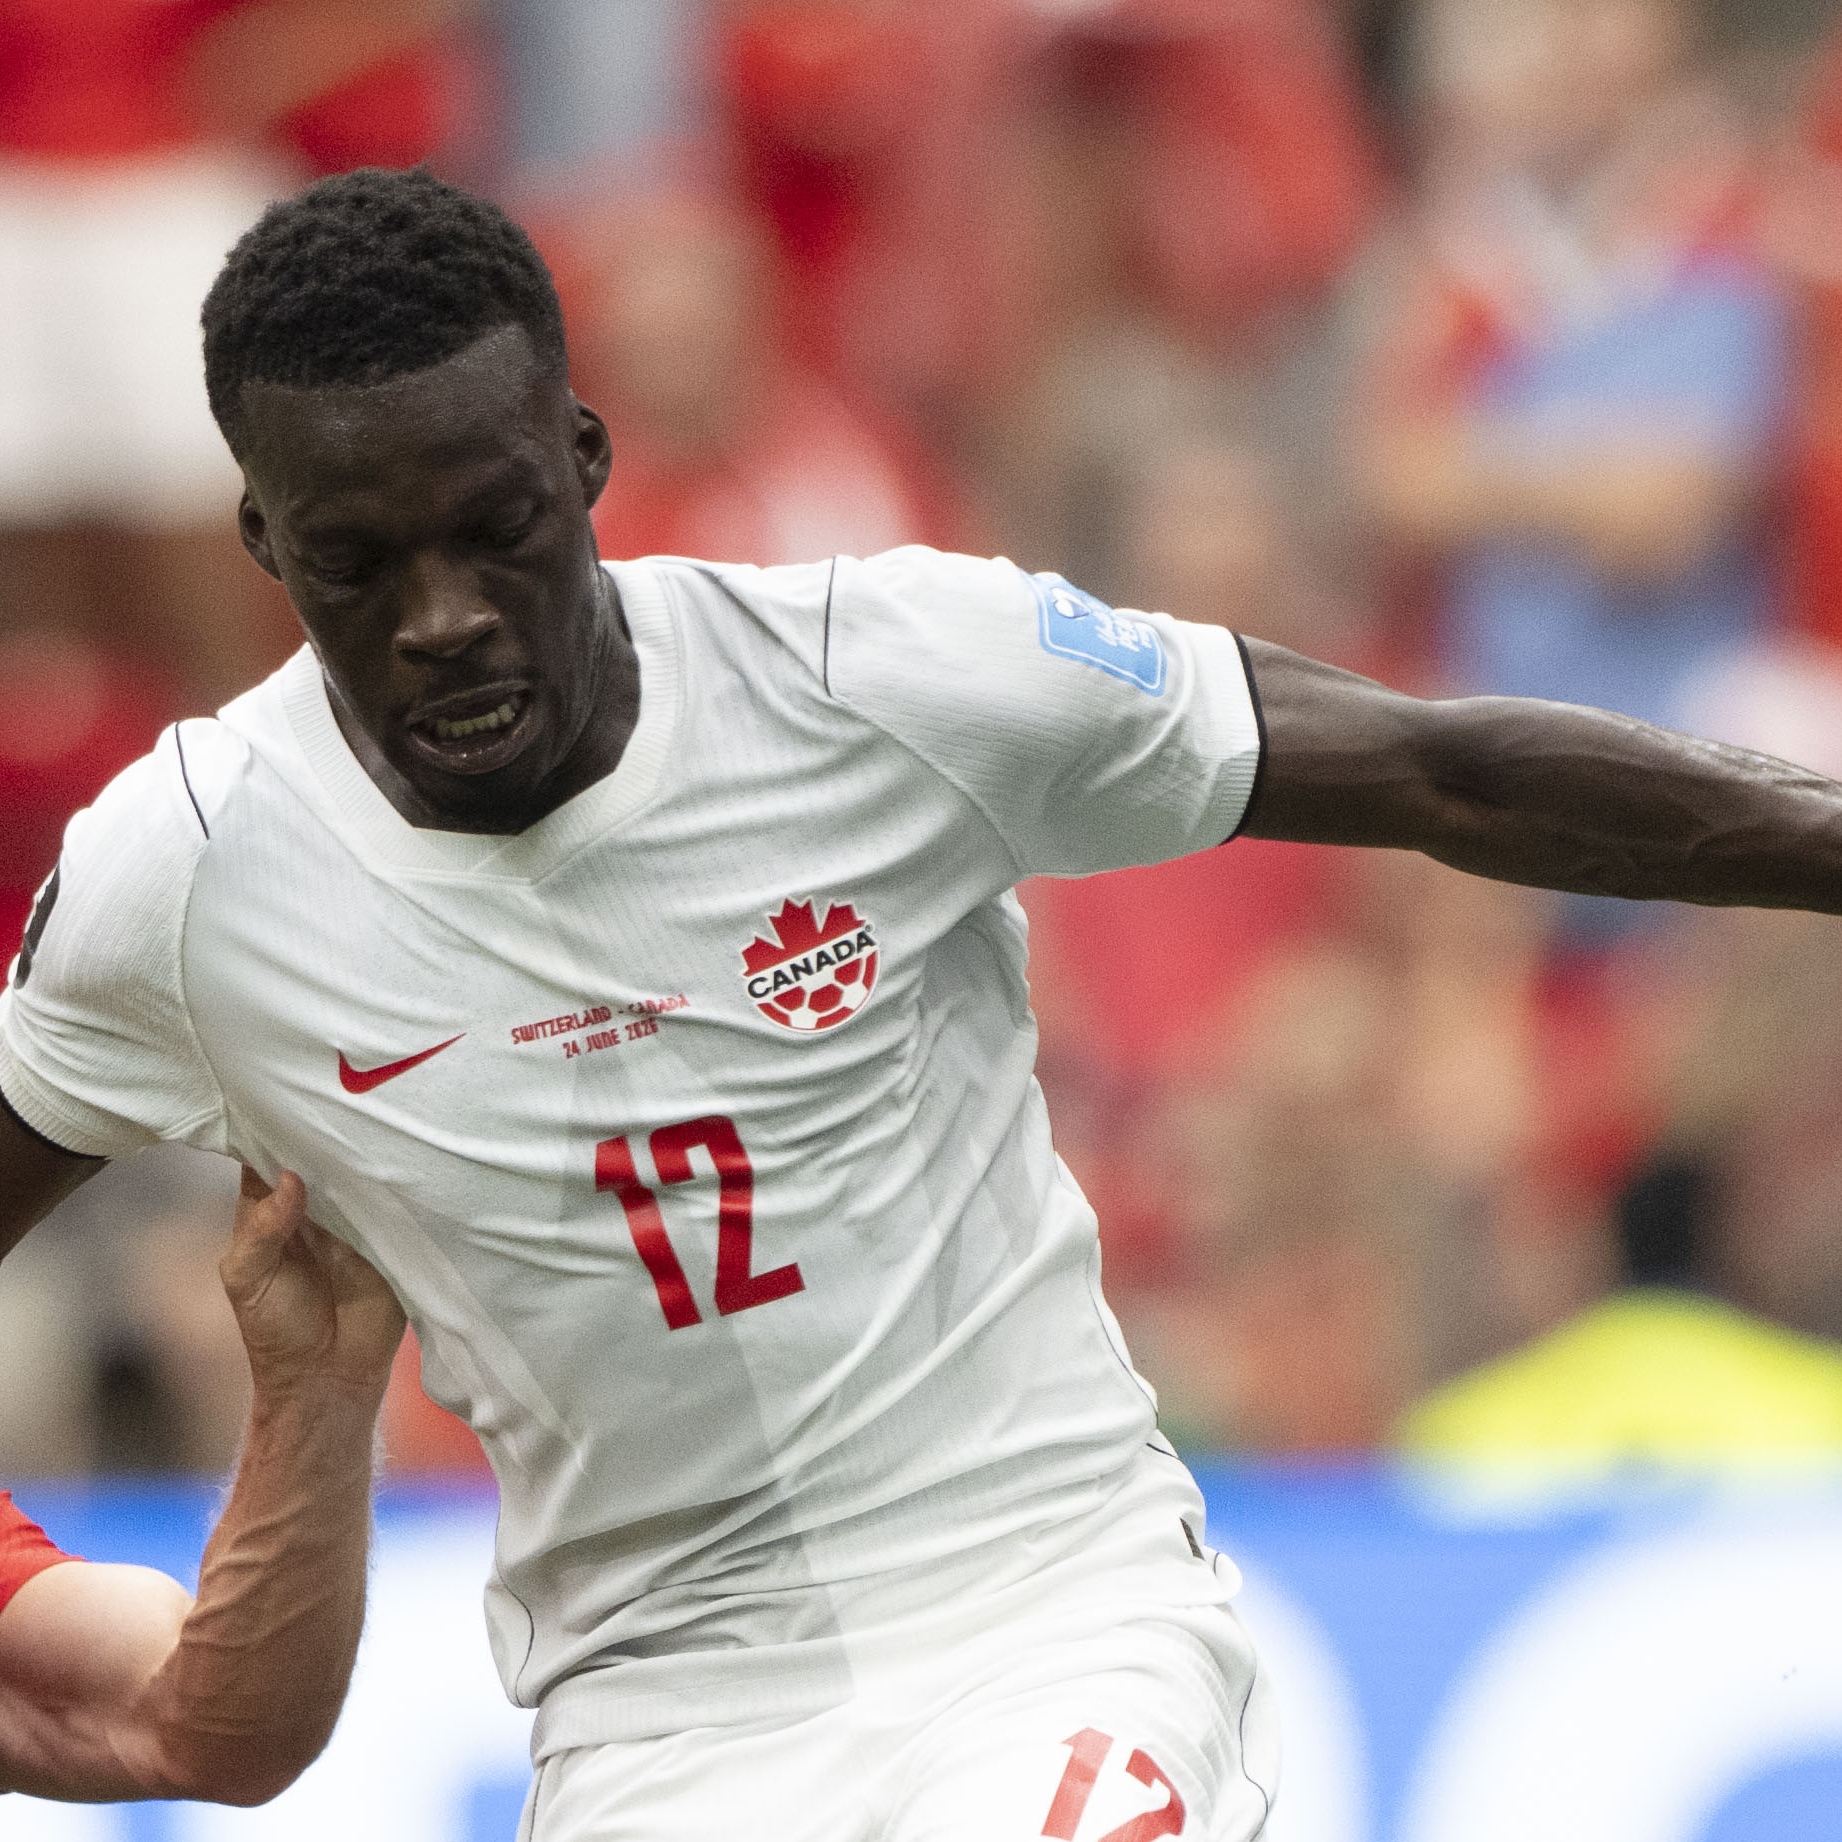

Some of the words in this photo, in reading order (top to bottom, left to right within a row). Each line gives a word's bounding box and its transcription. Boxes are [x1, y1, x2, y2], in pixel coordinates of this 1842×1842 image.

[748, 930, 876, 999] CANADA
[511, 1006, 612, 1045] SWITZERLAND
[628, 992, 691, 1016] CANADA
[562, 1039, 582, 1059] 24
[586, 1028, 622, 1053] JUNE
[624, 1017, 659, 1042] 2026
[594, 1114, 807, 1332] 12
